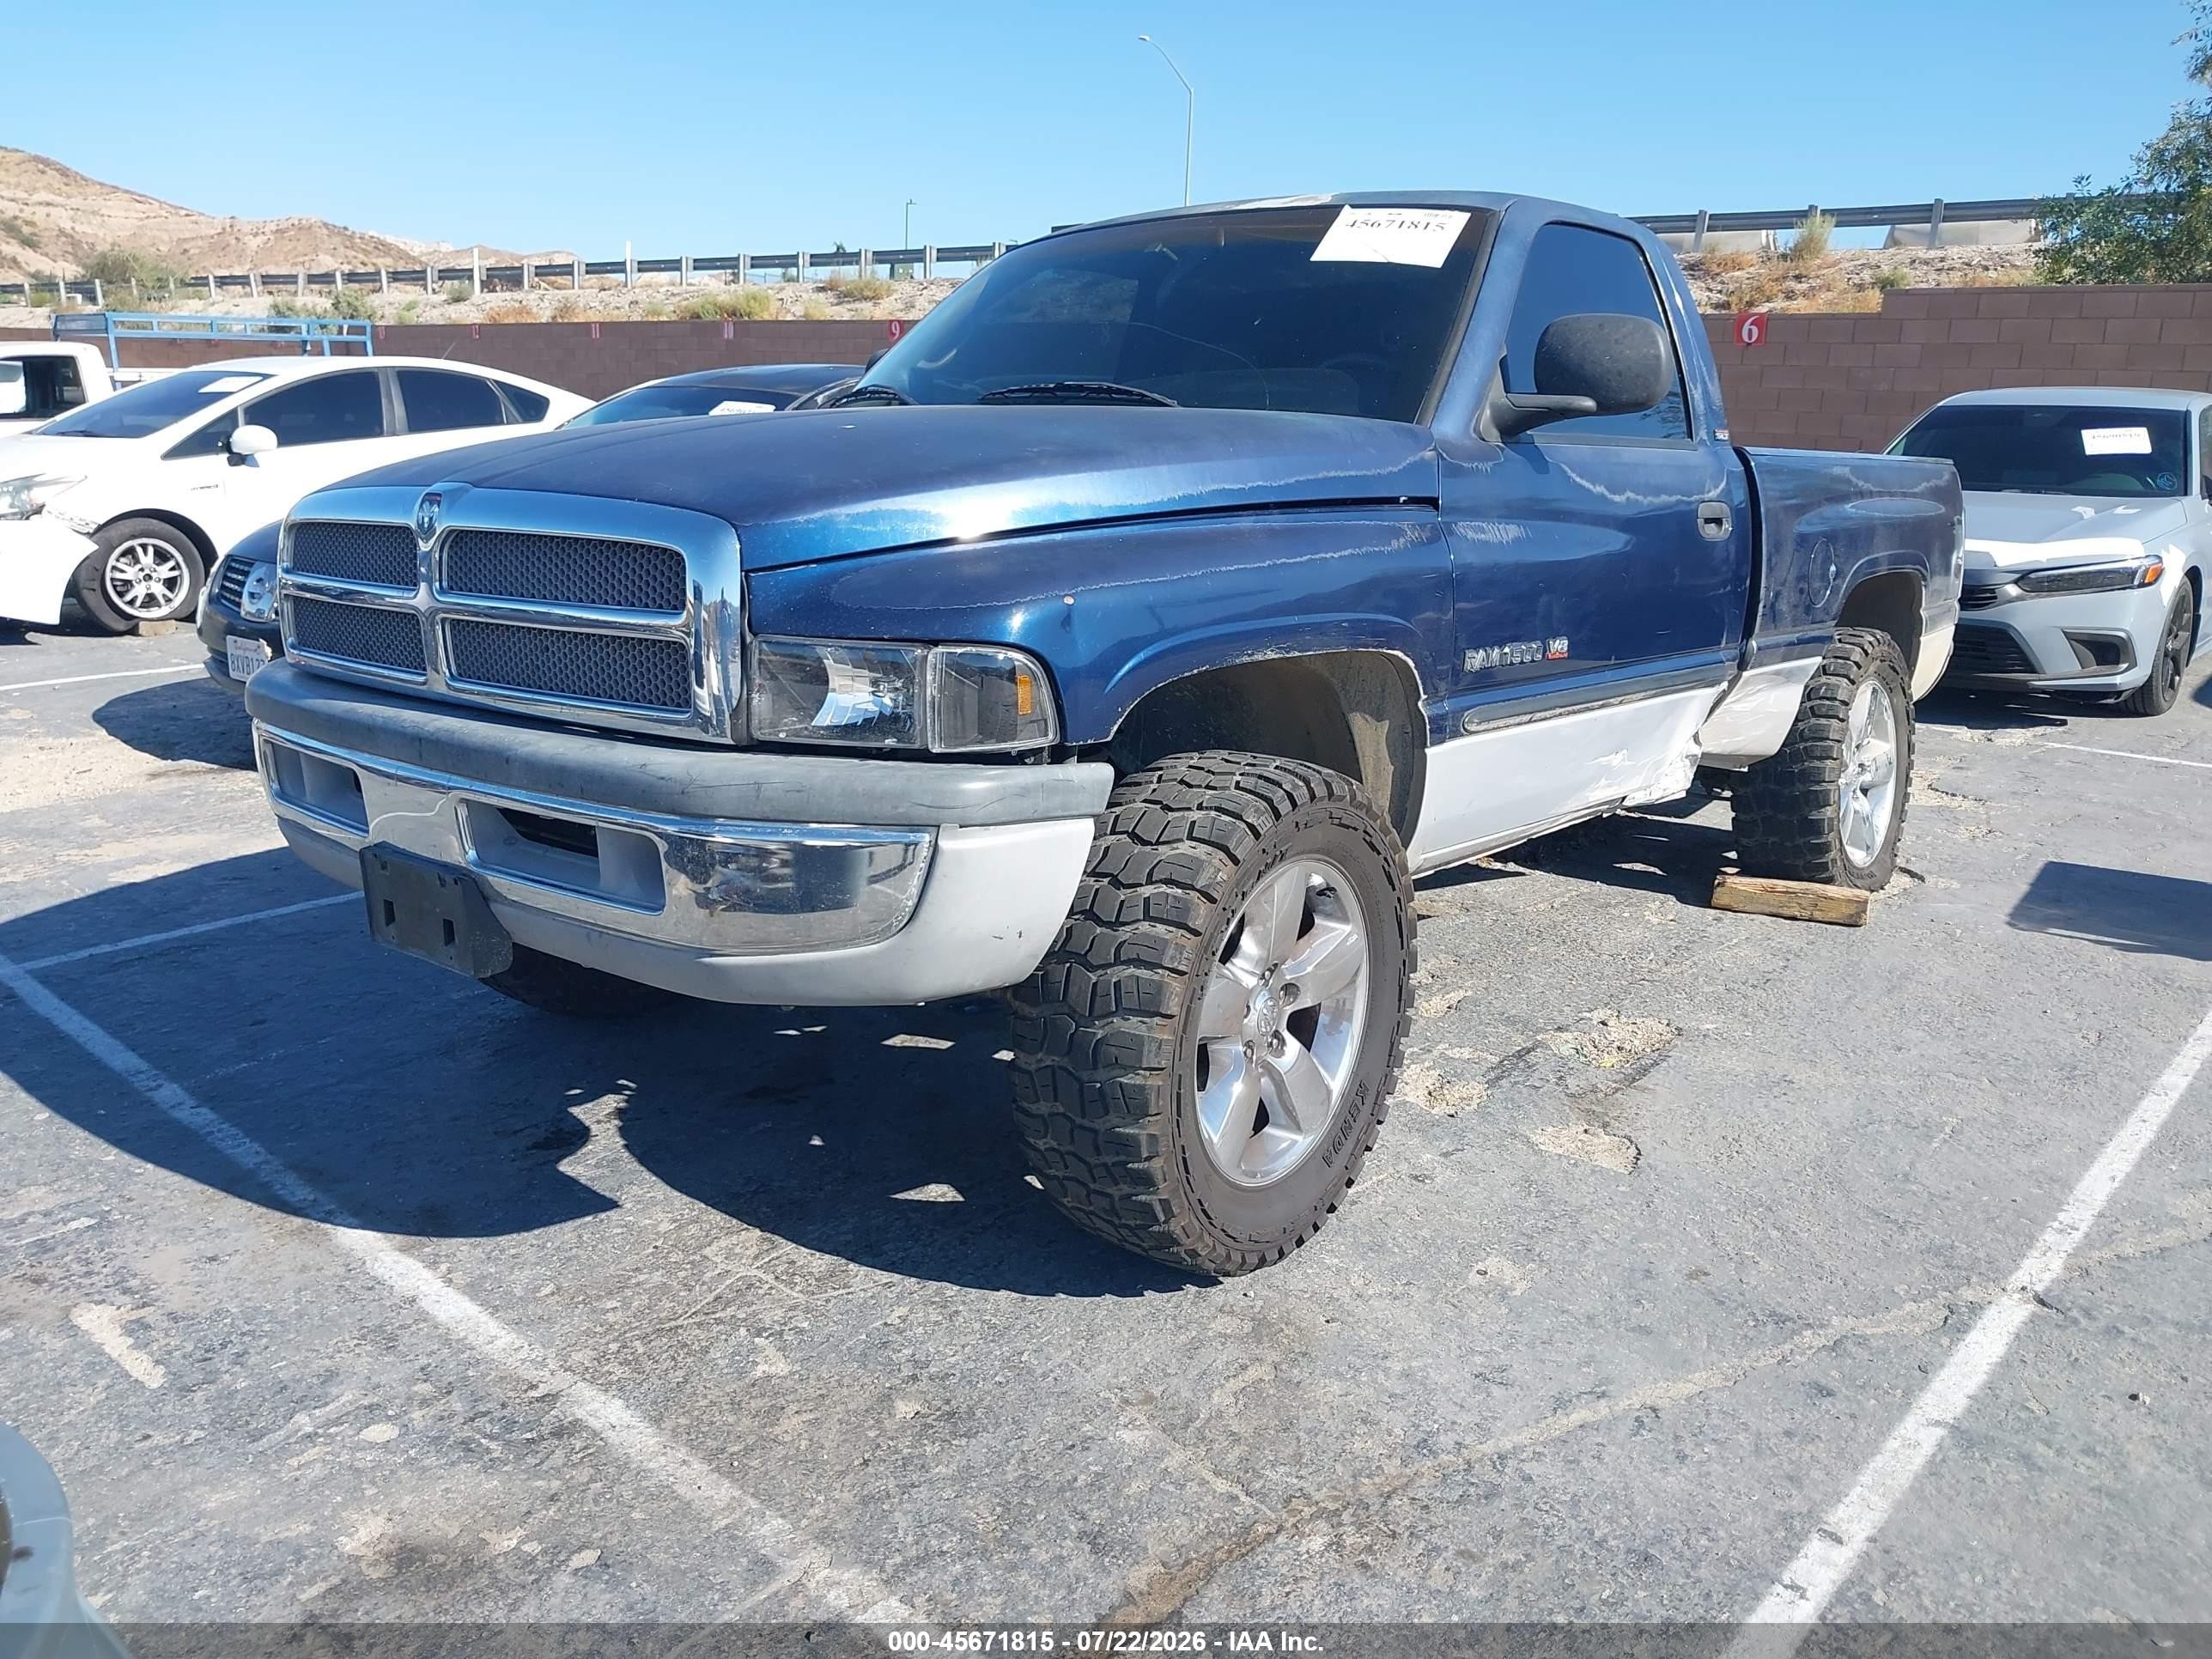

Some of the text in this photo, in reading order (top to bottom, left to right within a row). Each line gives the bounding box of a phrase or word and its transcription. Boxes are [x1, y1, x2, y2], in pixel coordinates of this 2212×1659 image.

[1346, 218, 1450, 234] 45671815
[891, 321, 900, 341] 9
[1741, 315, 1759, 343] 6
[1462, 636, 1568, 673] RAM 1500 V8
[1322, 1079, 1370, 1169] KENDA
